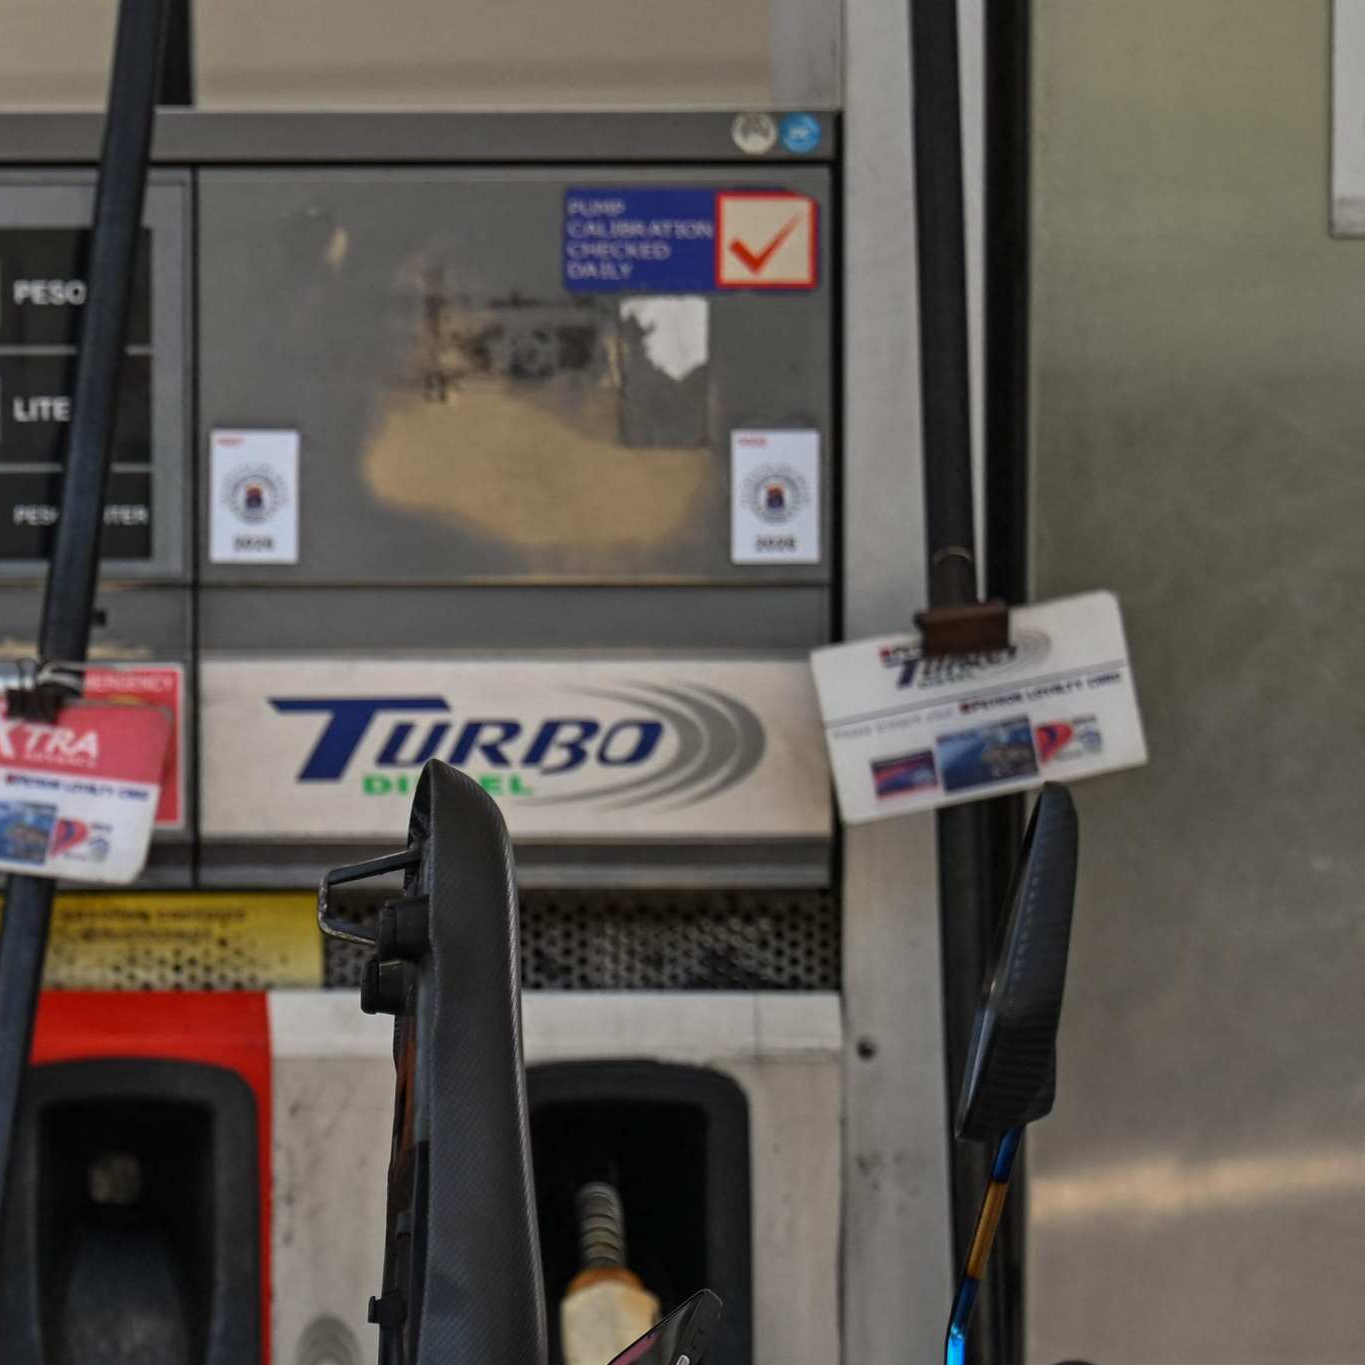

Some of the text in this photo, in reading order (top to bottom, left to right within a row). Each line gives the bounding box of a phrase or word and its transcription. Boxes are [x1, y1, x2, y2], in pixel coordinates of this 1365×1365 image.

[566, 219, 714, 239] CALIBRATION
[566, 241, 671, 260] CHECKED
[566, 262, 633, 279] DAILY
[13, 279, 87, 305] PESO
[13, 396, 71, 422] LITE
[266, 696, 666, 784] TURBO
[363, 774, 533, 796] DIEL
